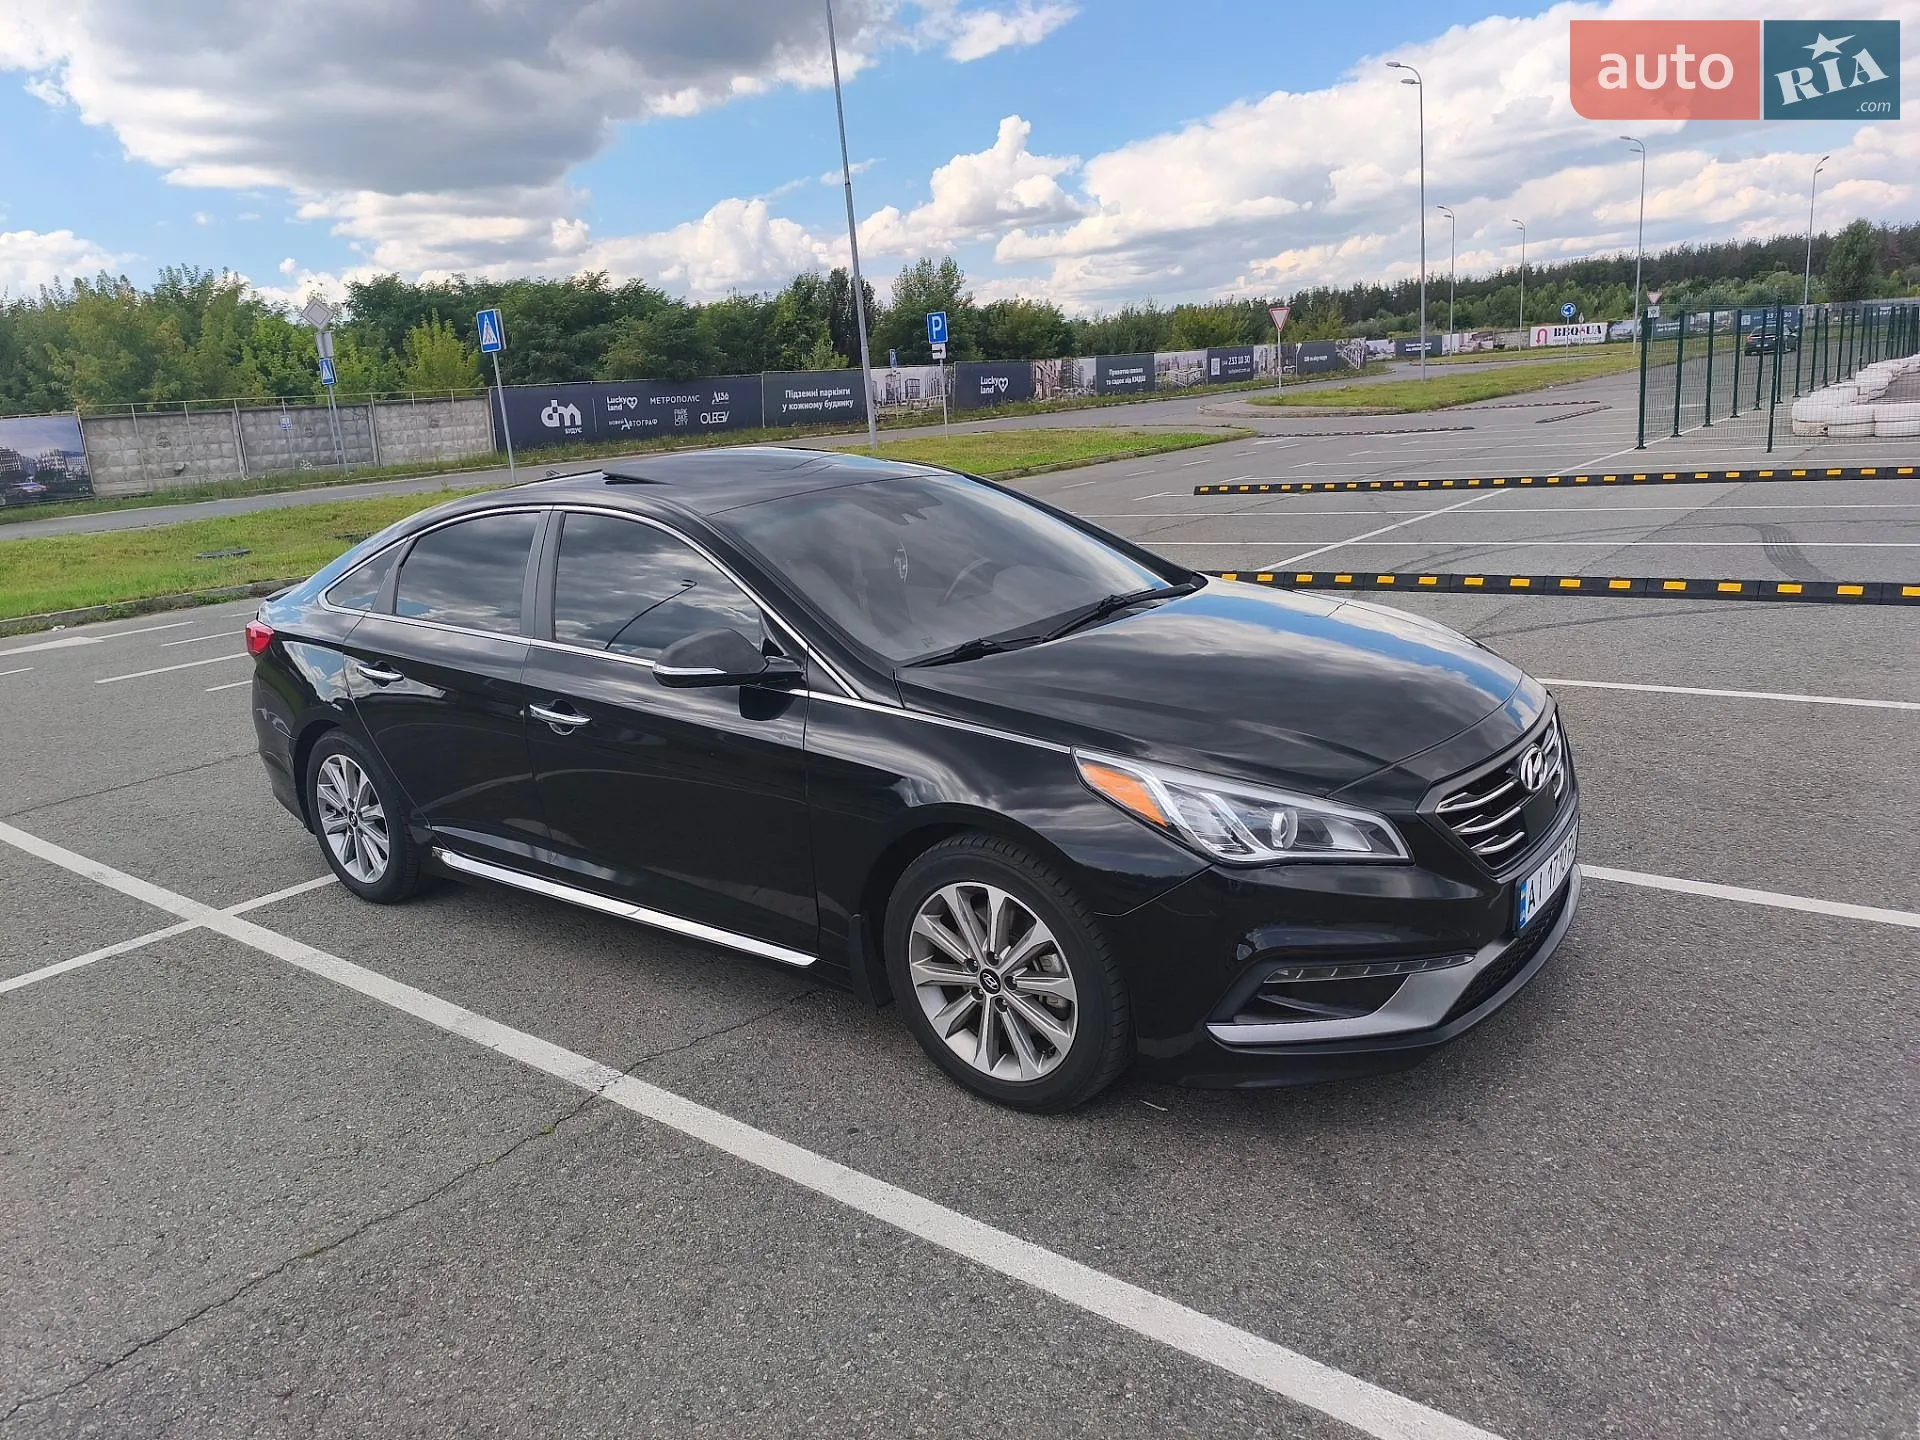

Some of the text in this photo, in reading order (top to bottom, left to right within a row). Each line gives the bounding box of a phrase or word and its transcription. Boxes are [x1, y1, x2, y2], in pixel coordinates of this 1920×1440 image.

[931, 315, 942, 339] P
[785, 388, 818, 399] Підземні
[606, 395, 627, 405] Lucky
[788, 402, 823, 411] кожному
[823, 399, 854, 410] будинку
